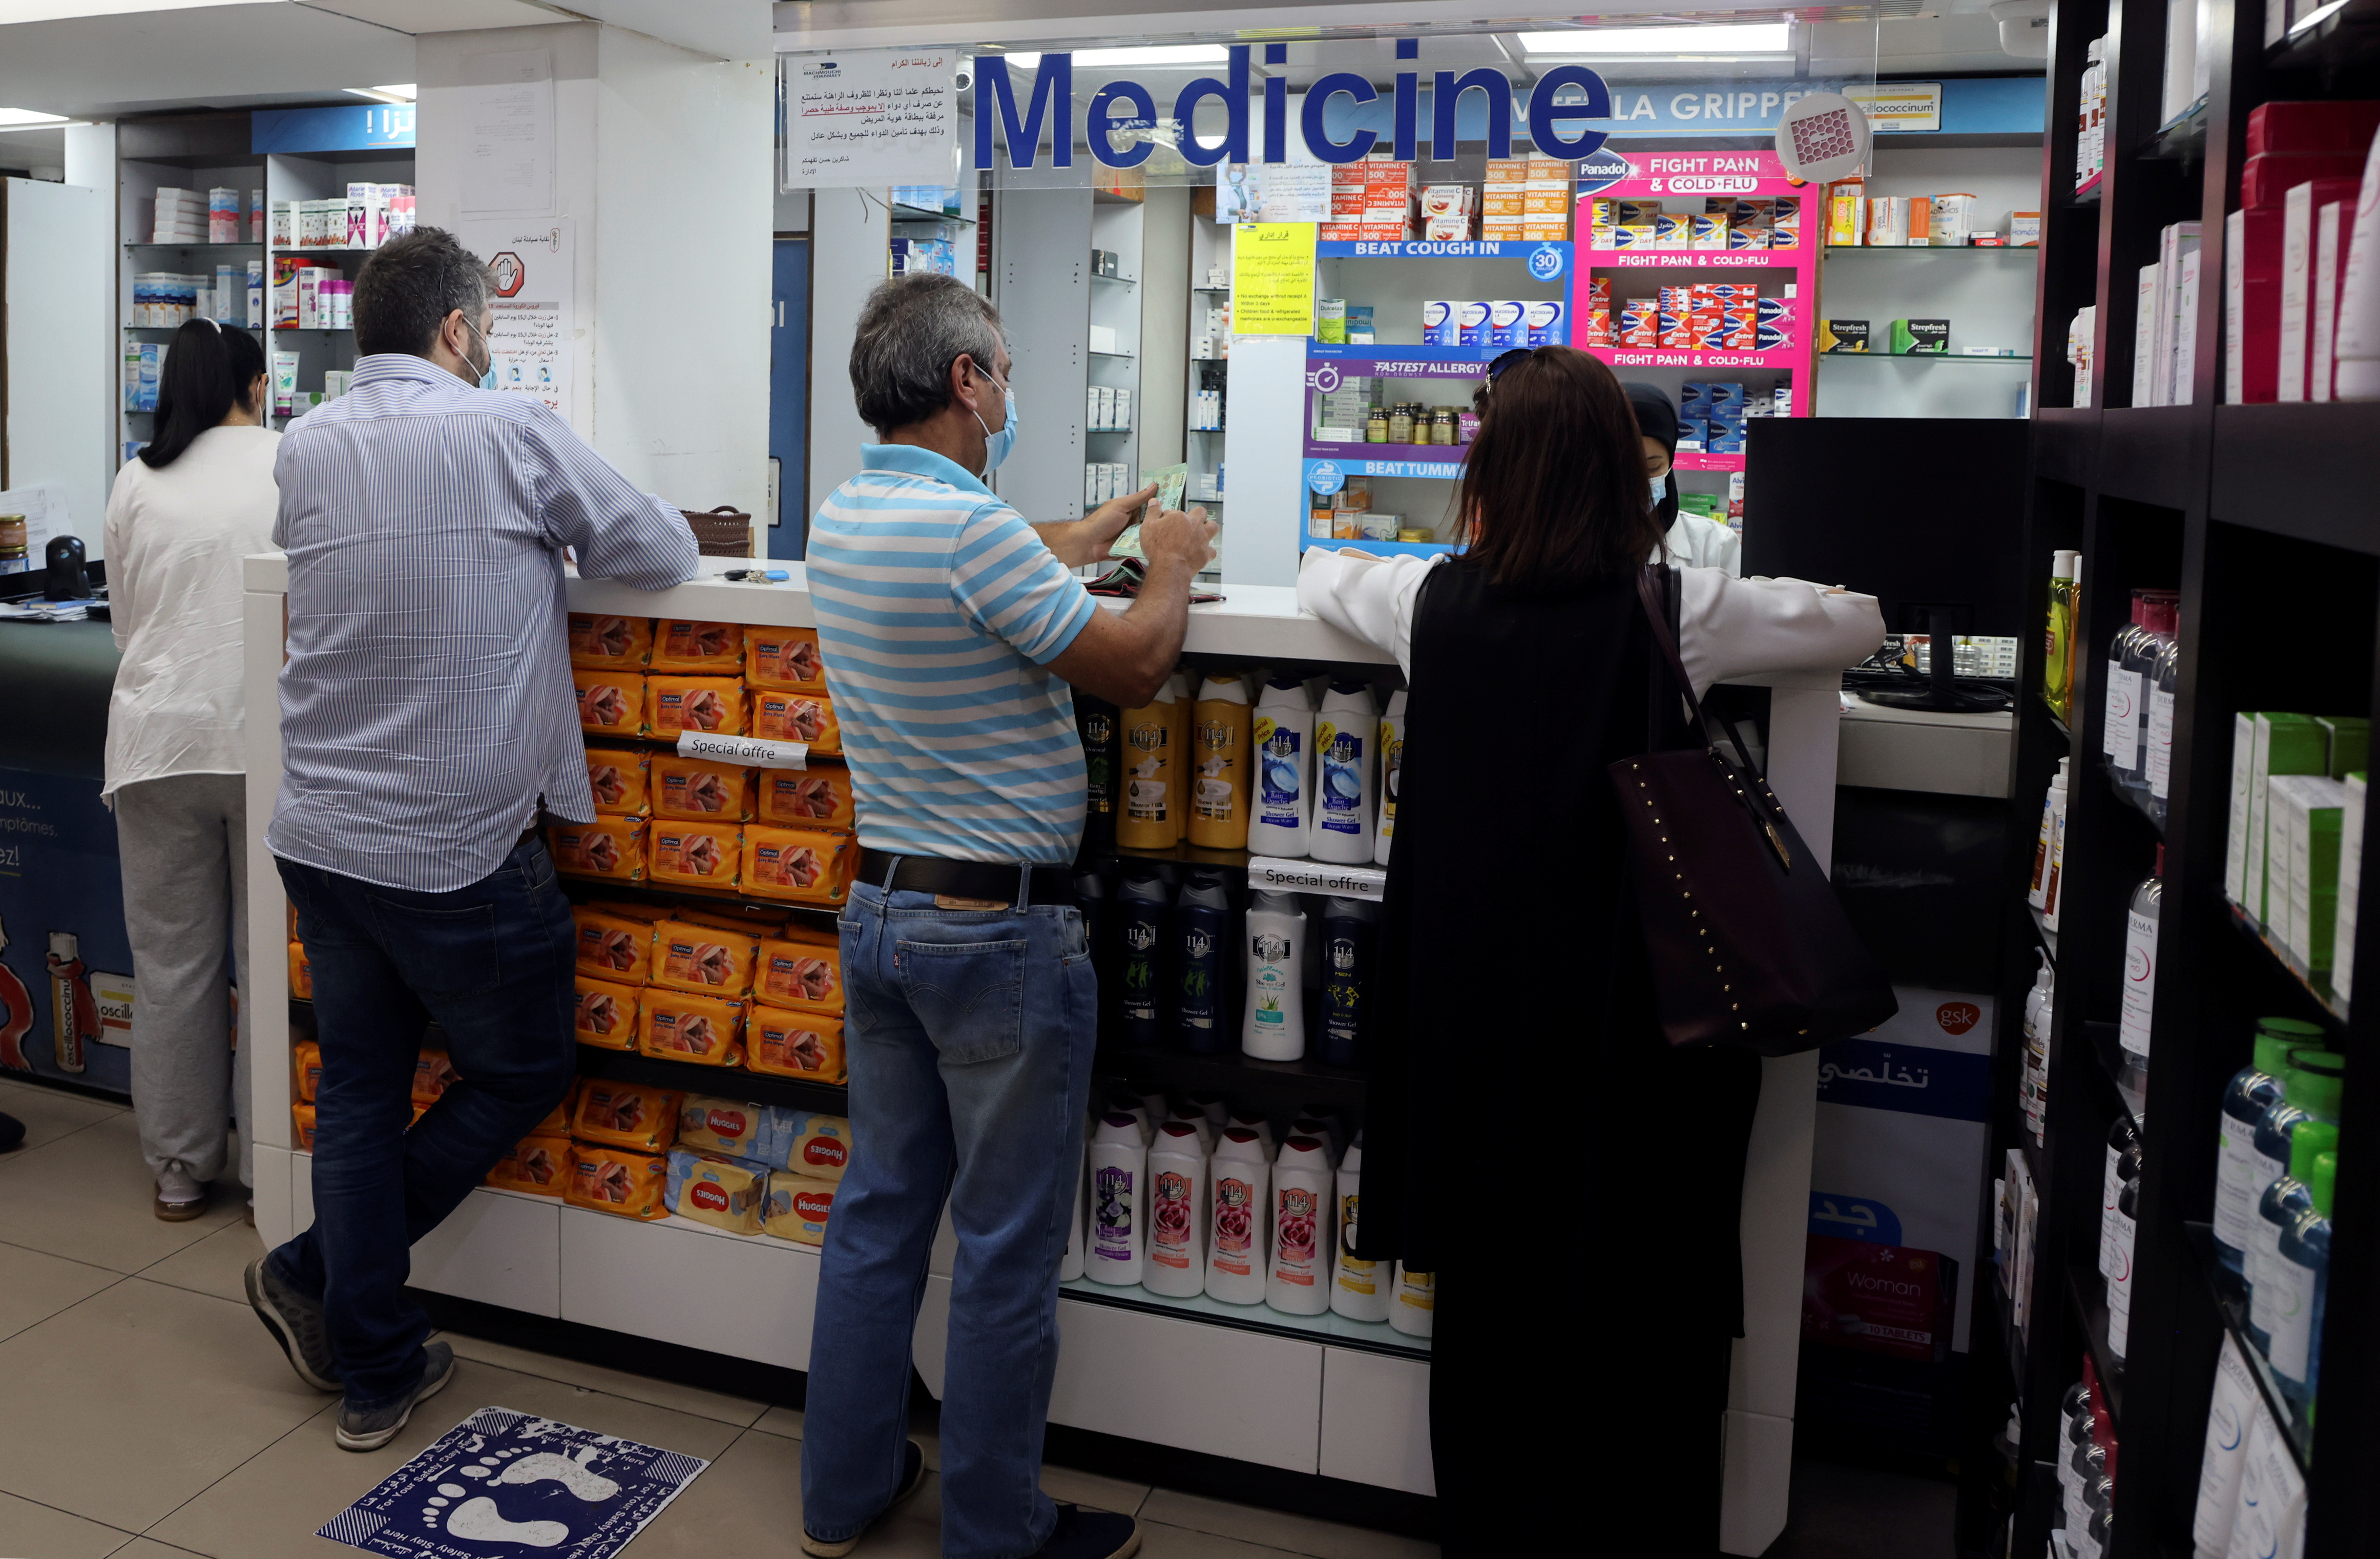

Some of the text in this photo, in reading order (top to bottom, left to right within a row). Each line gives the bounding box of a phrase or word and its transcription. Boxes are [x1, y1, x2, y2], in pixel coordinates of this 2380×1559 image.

[892, 60, 909, 70] الكرام
[933, 57, 943, 67] إلى
[824, 91, 844, 100] الراهنة
[847, 90, 871, 99] للظروف
[873, 89, 891, 97] ونظرا
[893, 87, 903, 96] أننا
[922, 87, 944, 95] نحيطكم
[836, 105, 853, 113] وصفة
[903, 100, 911, 111] أي
[974, 37, 1612, 170] Medicine
[1615, 95, 1657, 121] LA
[1862, 102, 1933, 113] cillococcinum
[802, 107, 819, 115] حصرا
[821, 106, 834, 114] طبية
[811, 126, 944, 141] وذلك بهدف تأمين الدواء للجميع وبشكل عادل
[1581, 163, 1626, 175] Panadol
[1651, 158, 1759, 173] FIGHT PAIN
[1650, 177, 1663, 192] &
[1355, 242, 1499, 255] BEAT COUGH IN
[1535, 254, 1555, 267] 30
[1618, 256, 1658, 266] FIGHT
[1661, 256, 1692, 266] PAIN
[1698, 256, 1707, 265] &
[1911, 323, 1947, 331] Strepfresh
[1373, 362, 1483, 373] FASTEST ALLERGY
[1366, 462, 1404, 474] BEAT
[1088, 721, 1106, 734] 114
[1139, 730, 1157, 742] 114
[1271, 735, 1291, 747] 114
[1321, 733, 1332, 747] Price
[692, 739, 775, 760] Special offre
[1266, 869, 1369, 892] Special offre
[1187, 935, 1205, 948] 114
[1260, 940, 1281, 954] 114
[673, 945, 692, 953] Optimal
[1334, 946, 1353, 959] 114
[1257, 966, 1284, 975] Wellness
[62, 980, 74, 1065] oscillococcinu
[1940, 1008, 1973, 1026] gsk
[711, 1116, 740, 1131] HUGGIES
[810, 1145, 843, 1160] HUGGIES
[1105, 1174, 1123, 1186] 114
[1287, 1194, 1308, 1208] 114
[1847, 1271, 1920, 1296] Woman
[1883, 1326, 1925, 1342] TABLETS
[621, 1455, 645, 1466] Here
[376, 1449, 461, 1511] For Your Safety Stay
